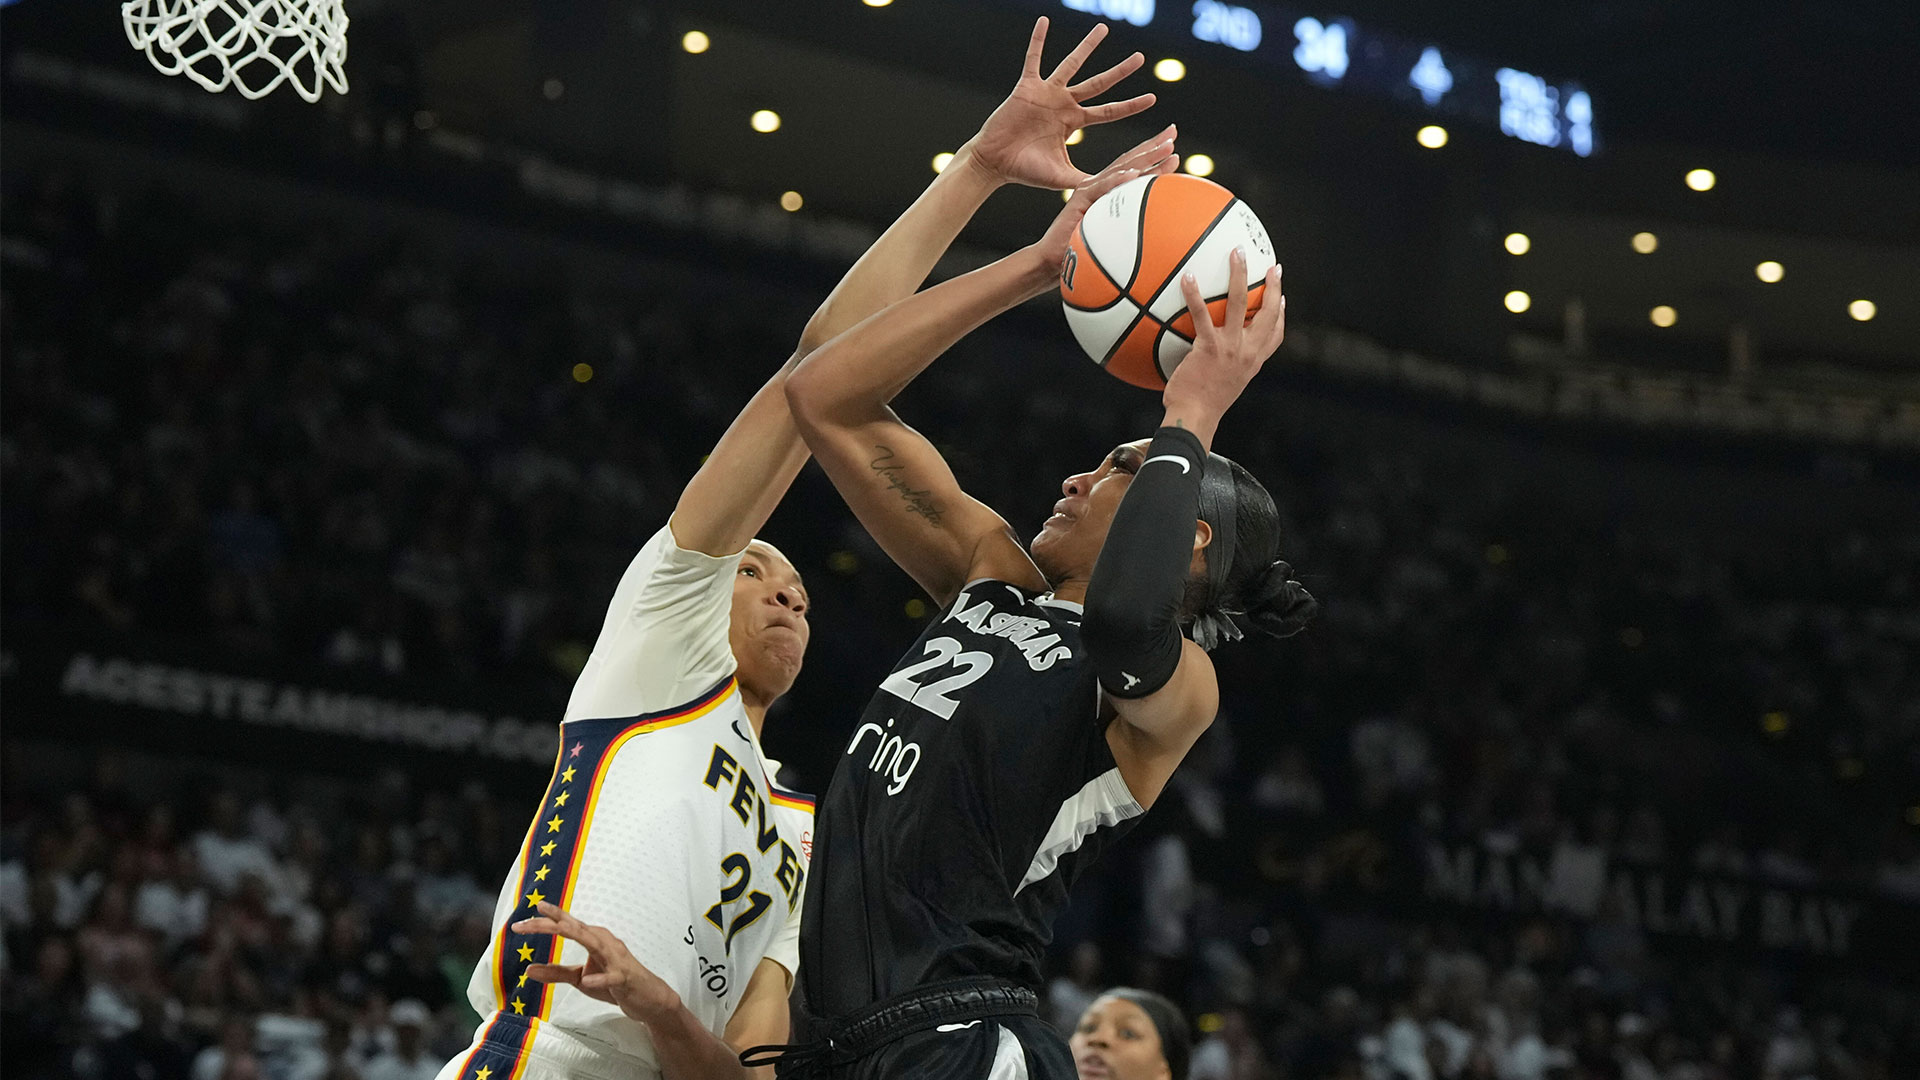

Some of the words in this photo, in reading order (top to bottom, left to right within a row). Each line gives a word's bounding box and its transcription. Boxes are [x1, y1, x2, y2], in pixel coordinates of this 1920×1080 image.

[1294, 17, 1348, 78] 34
[63, 655, 558, 763] ACESTEAMSHOP.CO
[879, 636, 994, 720] 22
[847, 718, 921, 796] ring
[703, 852, 773, 957] 21
[1424, 838, 1747, 940] MANALAY
[1762, 888, 1859, 955] BAY
